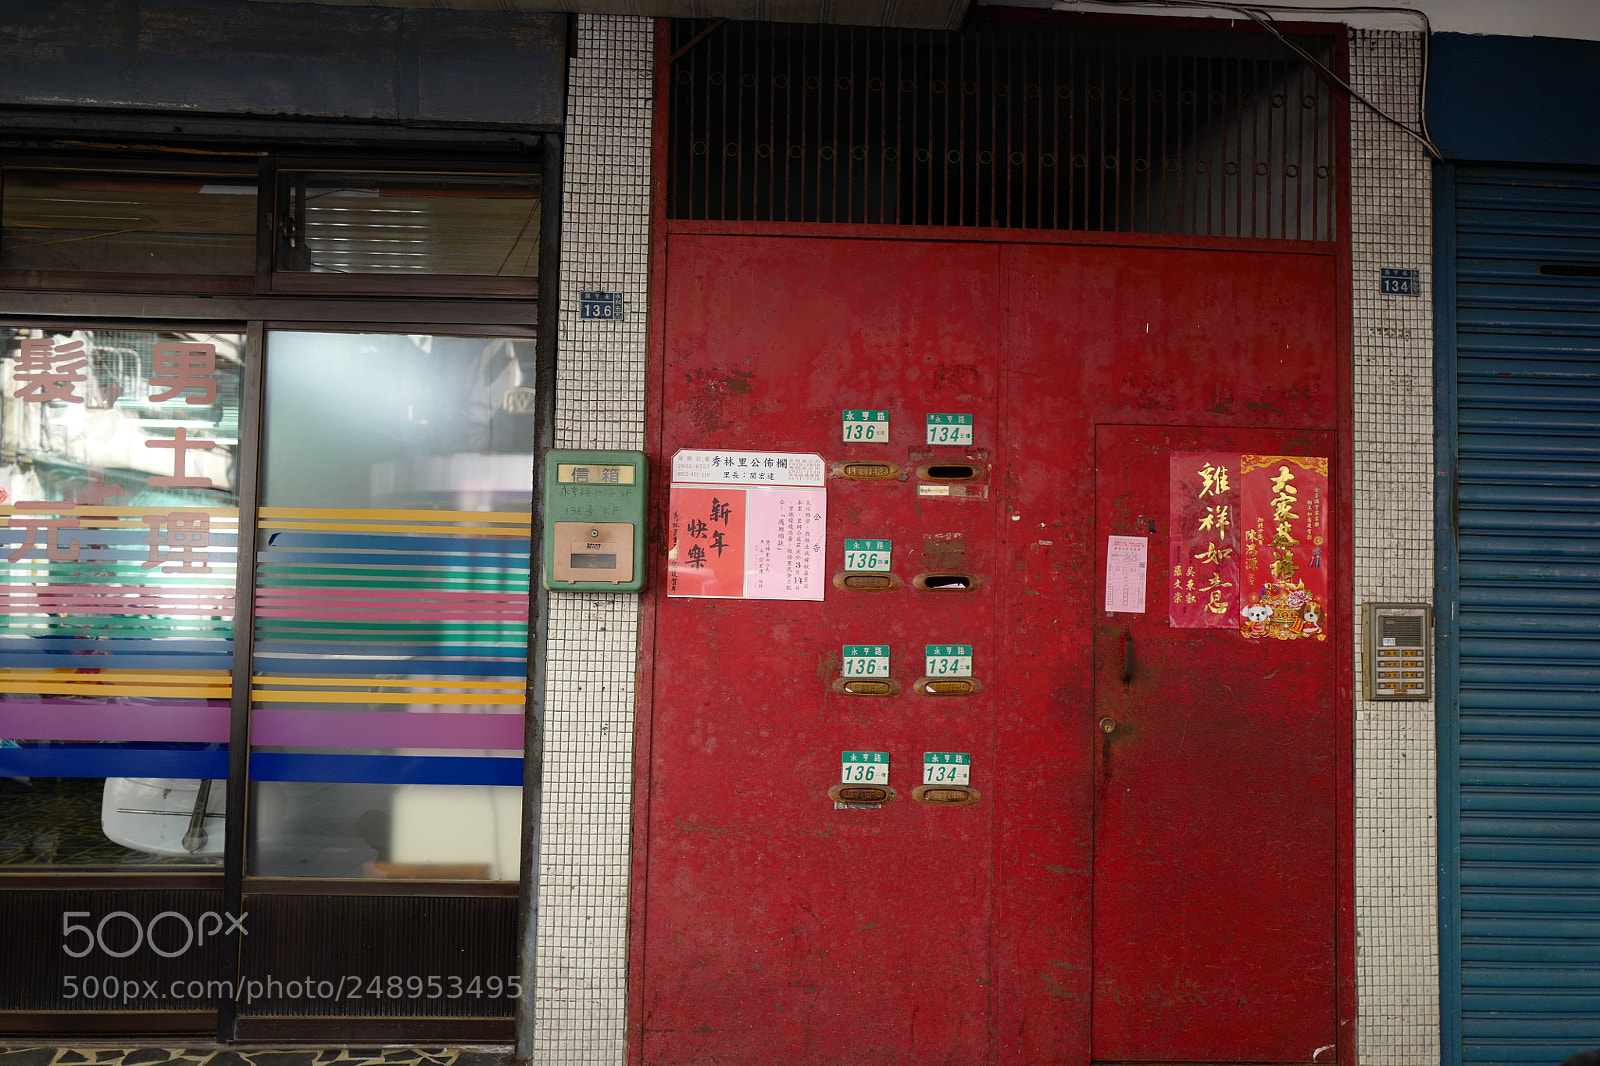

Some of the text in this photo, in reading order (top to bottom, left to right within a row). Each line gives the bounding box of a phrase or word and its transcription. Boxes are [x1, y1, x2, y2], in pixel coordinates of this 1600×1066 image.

[1385, 280, 1408, 293] 134
[584, 304, 612, 317] 136
[13, 338, 88, 403] 髮
[846, 425, 876, 440] 136
[930, 426, 960, 442] 134
[711, 455, 788, 469] 秀林里公佈欄
[571, 467, 620, 484] 信箱
[709, 497, 733, 558] 新年
[684, 518, 709, 570] 快樂
[848, 553, 878, 568] 136
[846, 659, 877, 674] 136
[929, 659, 959, 674] 134
[845, 765, 876, 781] 136
[926, 766, 957, 781] 134
